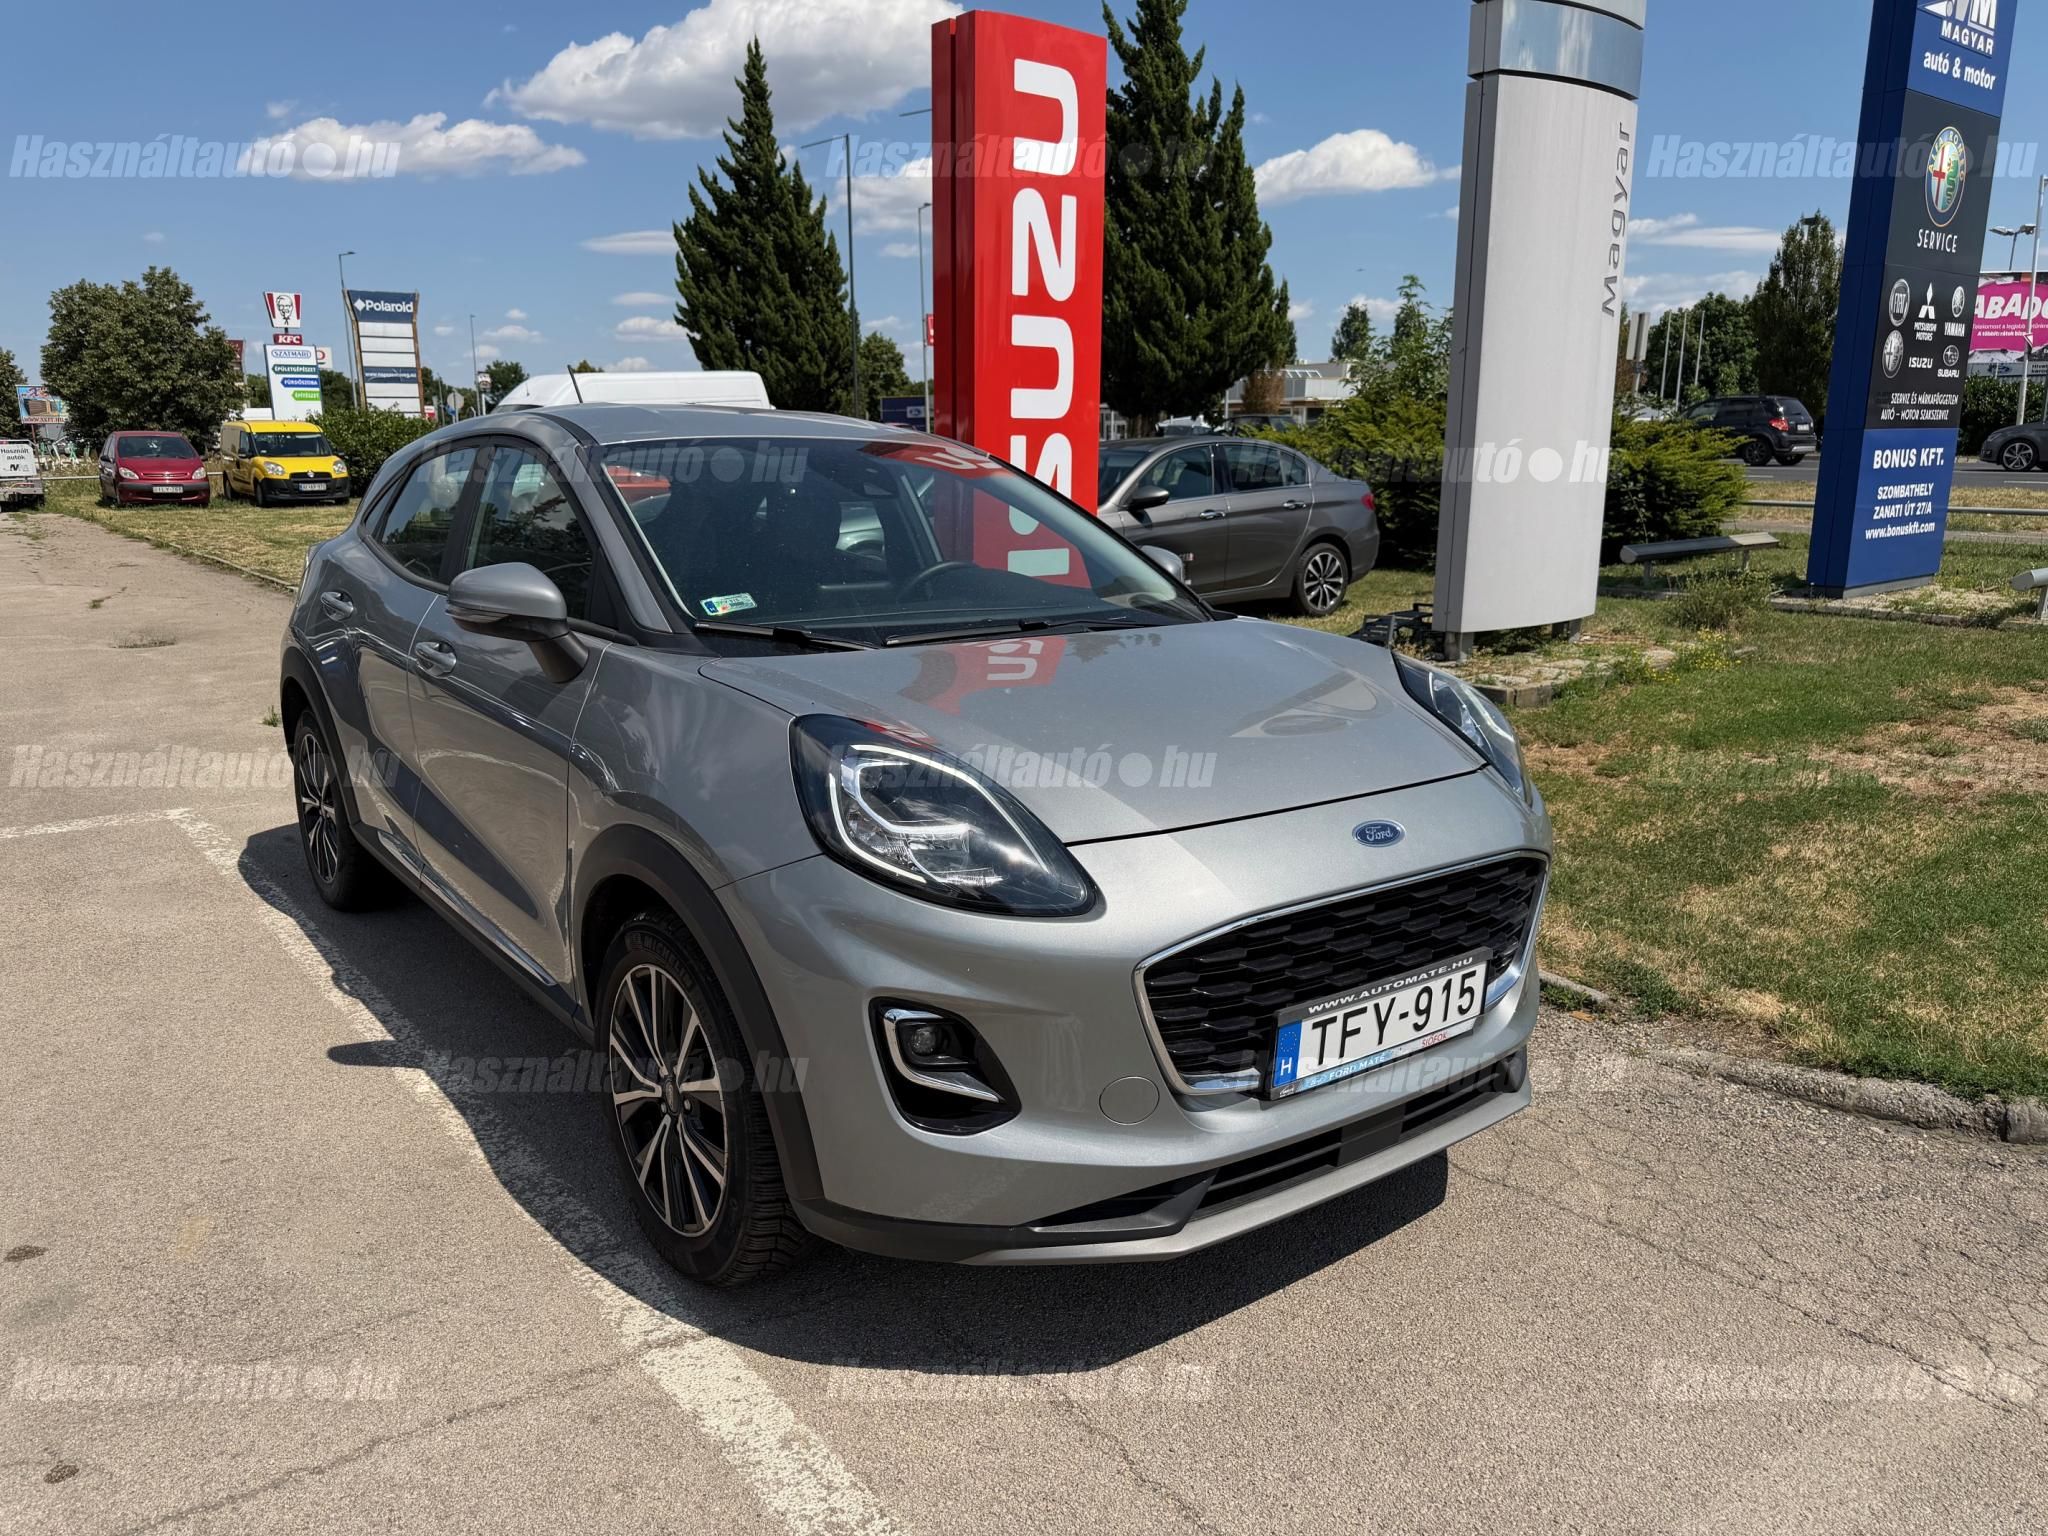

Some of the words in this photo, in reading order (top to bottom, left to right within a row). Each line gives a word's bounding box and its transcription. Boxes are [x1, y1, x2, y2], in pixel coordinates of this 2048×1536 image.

[1941, 20, 1994, 55] MAGYAR
[1923, 51, 1949, 75] autó
[1952, 57, 1961, 78] &
[1963, 66, 1996, 90] motor
[1601, 122, 1630, 318] Magyar
[1916, 228, 1958, 253] SERVICE
[365, 300, 414, 313] Polaroid
[1914, 321, 1937, 332] MITSUBISHI
[1944, 322, 1966, 337] YAMAHA
[278, 335, 301, 343] KFC
[1915, 332, 1933, 341] MOTORS
[1908, 356, 1933, 369] ISUZU
[1937, 368, 1960, 378] SUBARU
[1891, 392, 1911, 405] SZERVIZ
[1911, 391, 1918, 404] ÉS
[1918, 391, 1959, 406] MÁRKAFÜGGETLEN
[1881, 409, 1895, 420] AUTÓ
[1901, 410, 1920, 421] MOTOR
[1920, 410, 1949, 421] SZAKSZERVIZ
[1873, 448, 1917, 470] BONUS
[1920, 447, 1945, 466] KFT.
[1877, 483, 1934, 500] SZOMBATHELY
[1873, 503, 1903, 520] ZANATI
[1904, 500, 1915, 517] ÚT
[1865, 521, 1936, 540] www.bonuskft.com
[643, 935, 695, 991] MICHELIN
[1308, 957, 1474, 1015] WWW.AUTOMATE.HU
[1311, 969, 1478, 1066] TFY-915
[1280, 1057, 1292, 1076] H
[1329, 1063, 1357, 1080] FORD
